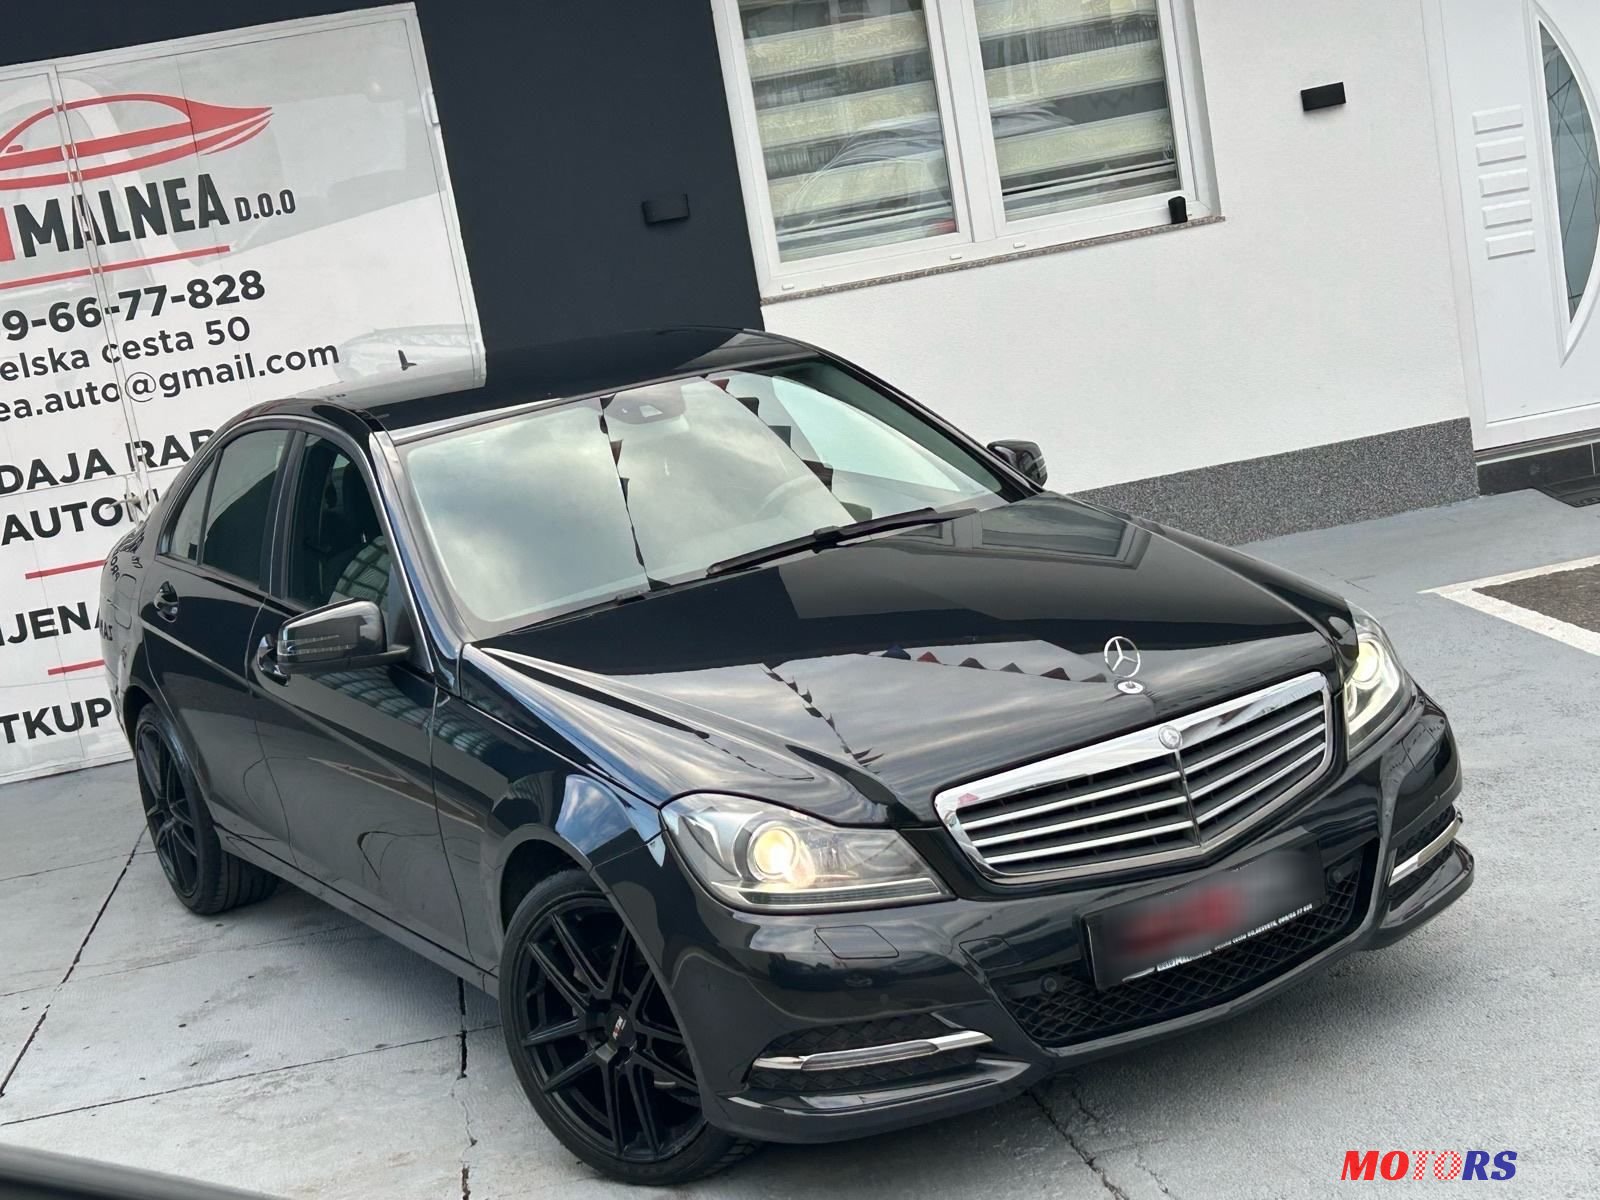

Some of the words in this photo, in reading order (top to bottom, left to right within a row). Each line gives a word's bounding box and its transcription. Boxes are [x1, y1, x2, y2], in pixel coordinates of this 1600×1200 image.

[14, 174, 230, 257] MALNEA
[234, 189, 297, 222] D.O.O
[2, 270, 266, 341] 9-66-77-828
[0, 347, 90, 382] elska
[101, 330, 194, 365] cesta
[205, 316, 251, 346] 50
[0, 697, 112, 744] TKUP
